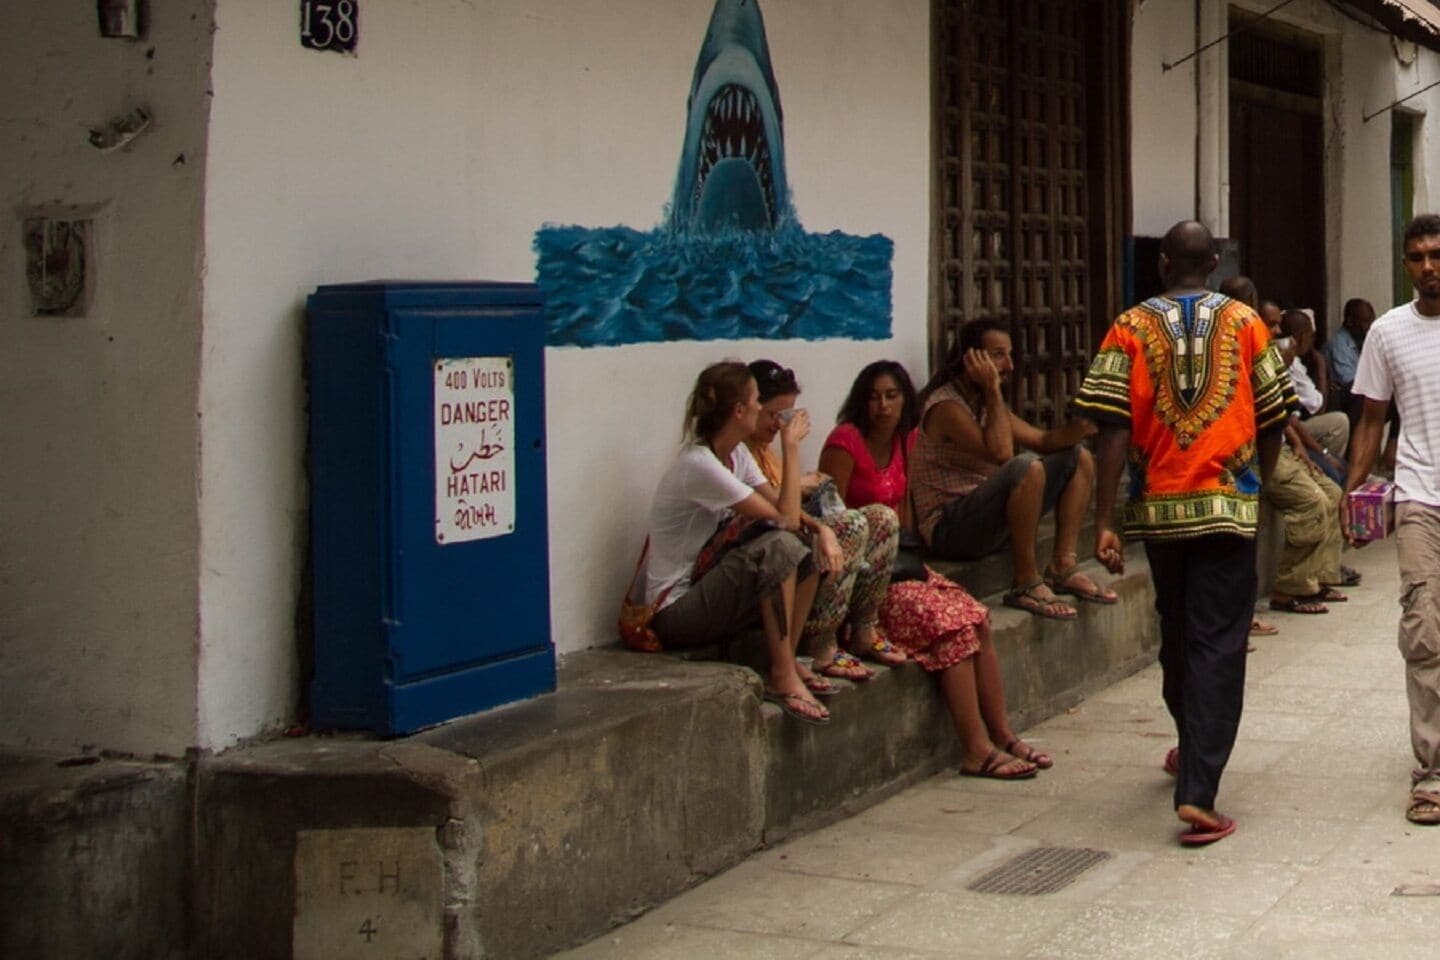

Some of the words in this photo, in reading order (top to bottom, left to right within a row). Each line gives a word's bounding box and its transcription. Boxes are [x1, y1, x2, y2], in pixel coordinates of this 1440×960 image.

[301, 0, 354, 47] 138
[445, 371, 468, 390] 400
[441, 399, 510, 426] DANGER
[447, 470, 506, 498] HATARI
